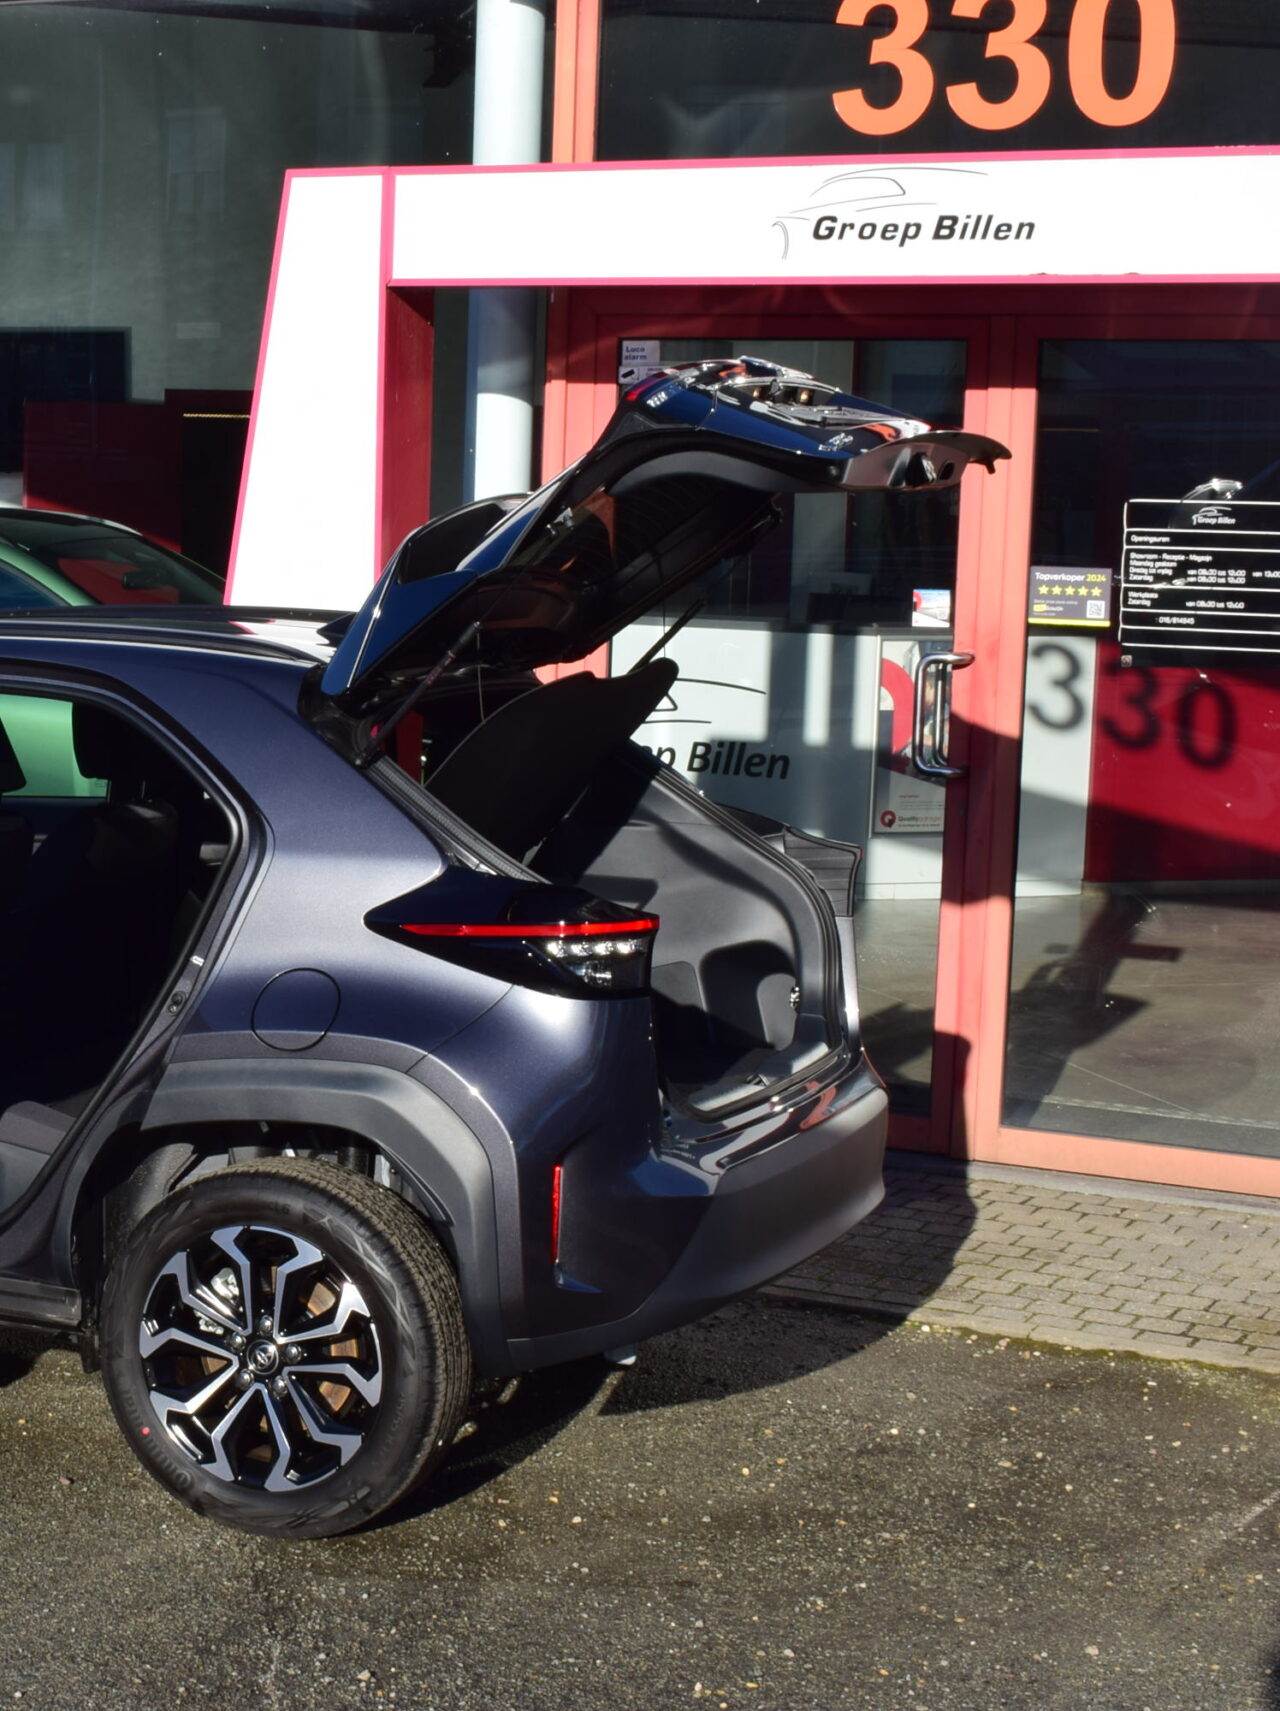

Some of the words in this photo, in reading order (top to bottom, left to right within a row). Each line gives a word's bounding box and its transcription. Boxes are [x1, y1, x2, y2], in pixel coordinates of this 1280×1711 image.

[832, 0, 1176, 136] 330
[812, 215, 922, 247] Groep
[932, 214, 1036, 241] Billen
[1035, 572, 1085, 582] Topverkoper
[1086, 573, 1107, 582] 2024
[687, 741, 790, 780] Billen
